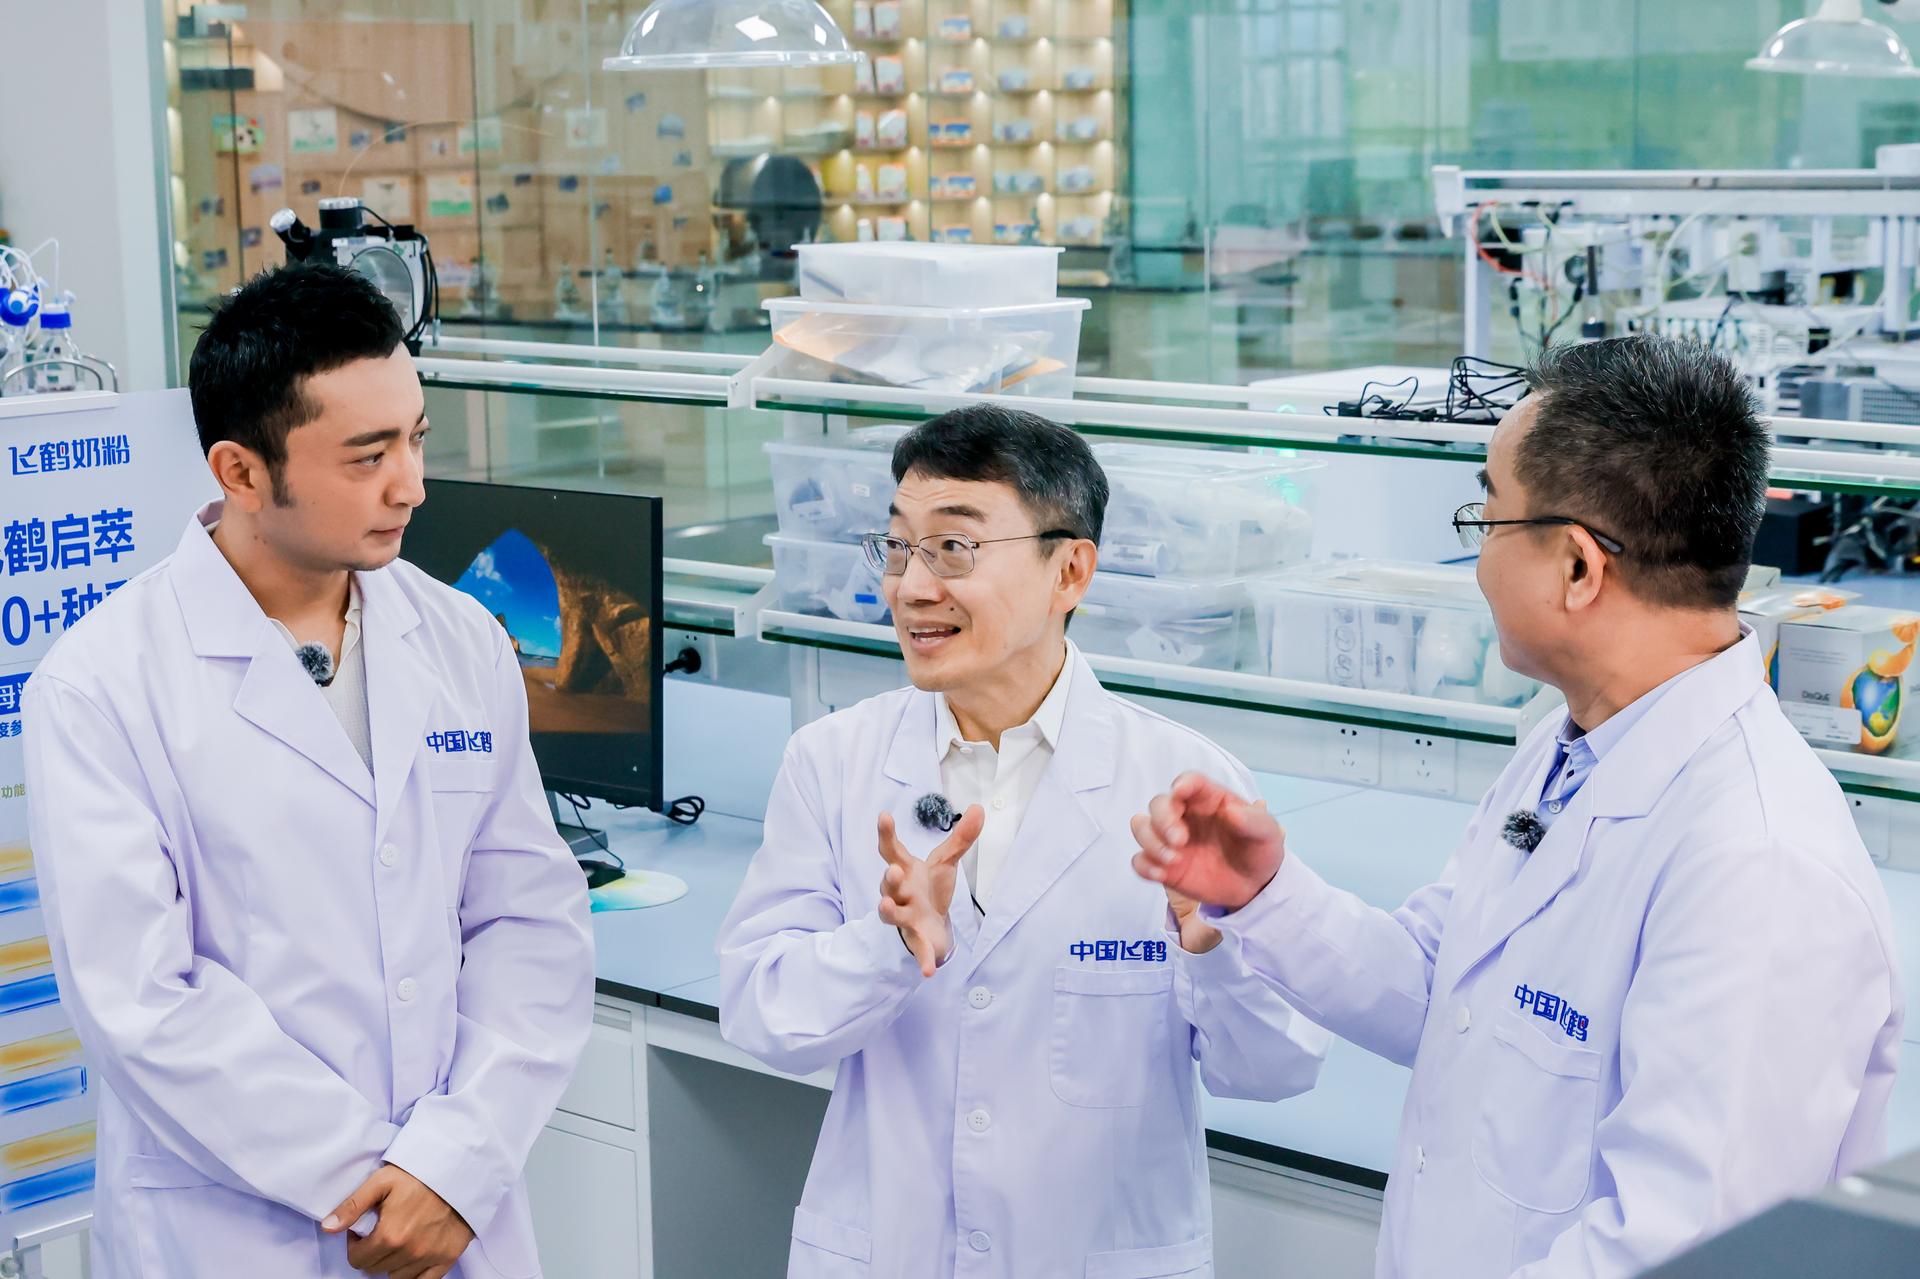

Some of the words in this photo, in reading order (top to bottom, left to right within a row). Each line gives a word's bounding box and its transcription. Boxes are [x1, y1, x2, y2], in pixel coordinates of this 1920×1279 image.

[8, 434, 130, 475] 飞鹤奶粉
[0, 507, 135, 576] 鹤启萃
[2, 579, 128, 646] 0+种
[426, 730, 492, 753] 中国飞鹤
[1070, 940, 1167, 962] 中国飞鹤
[1514, 983, 1589, 1042] 中国飞鹤
